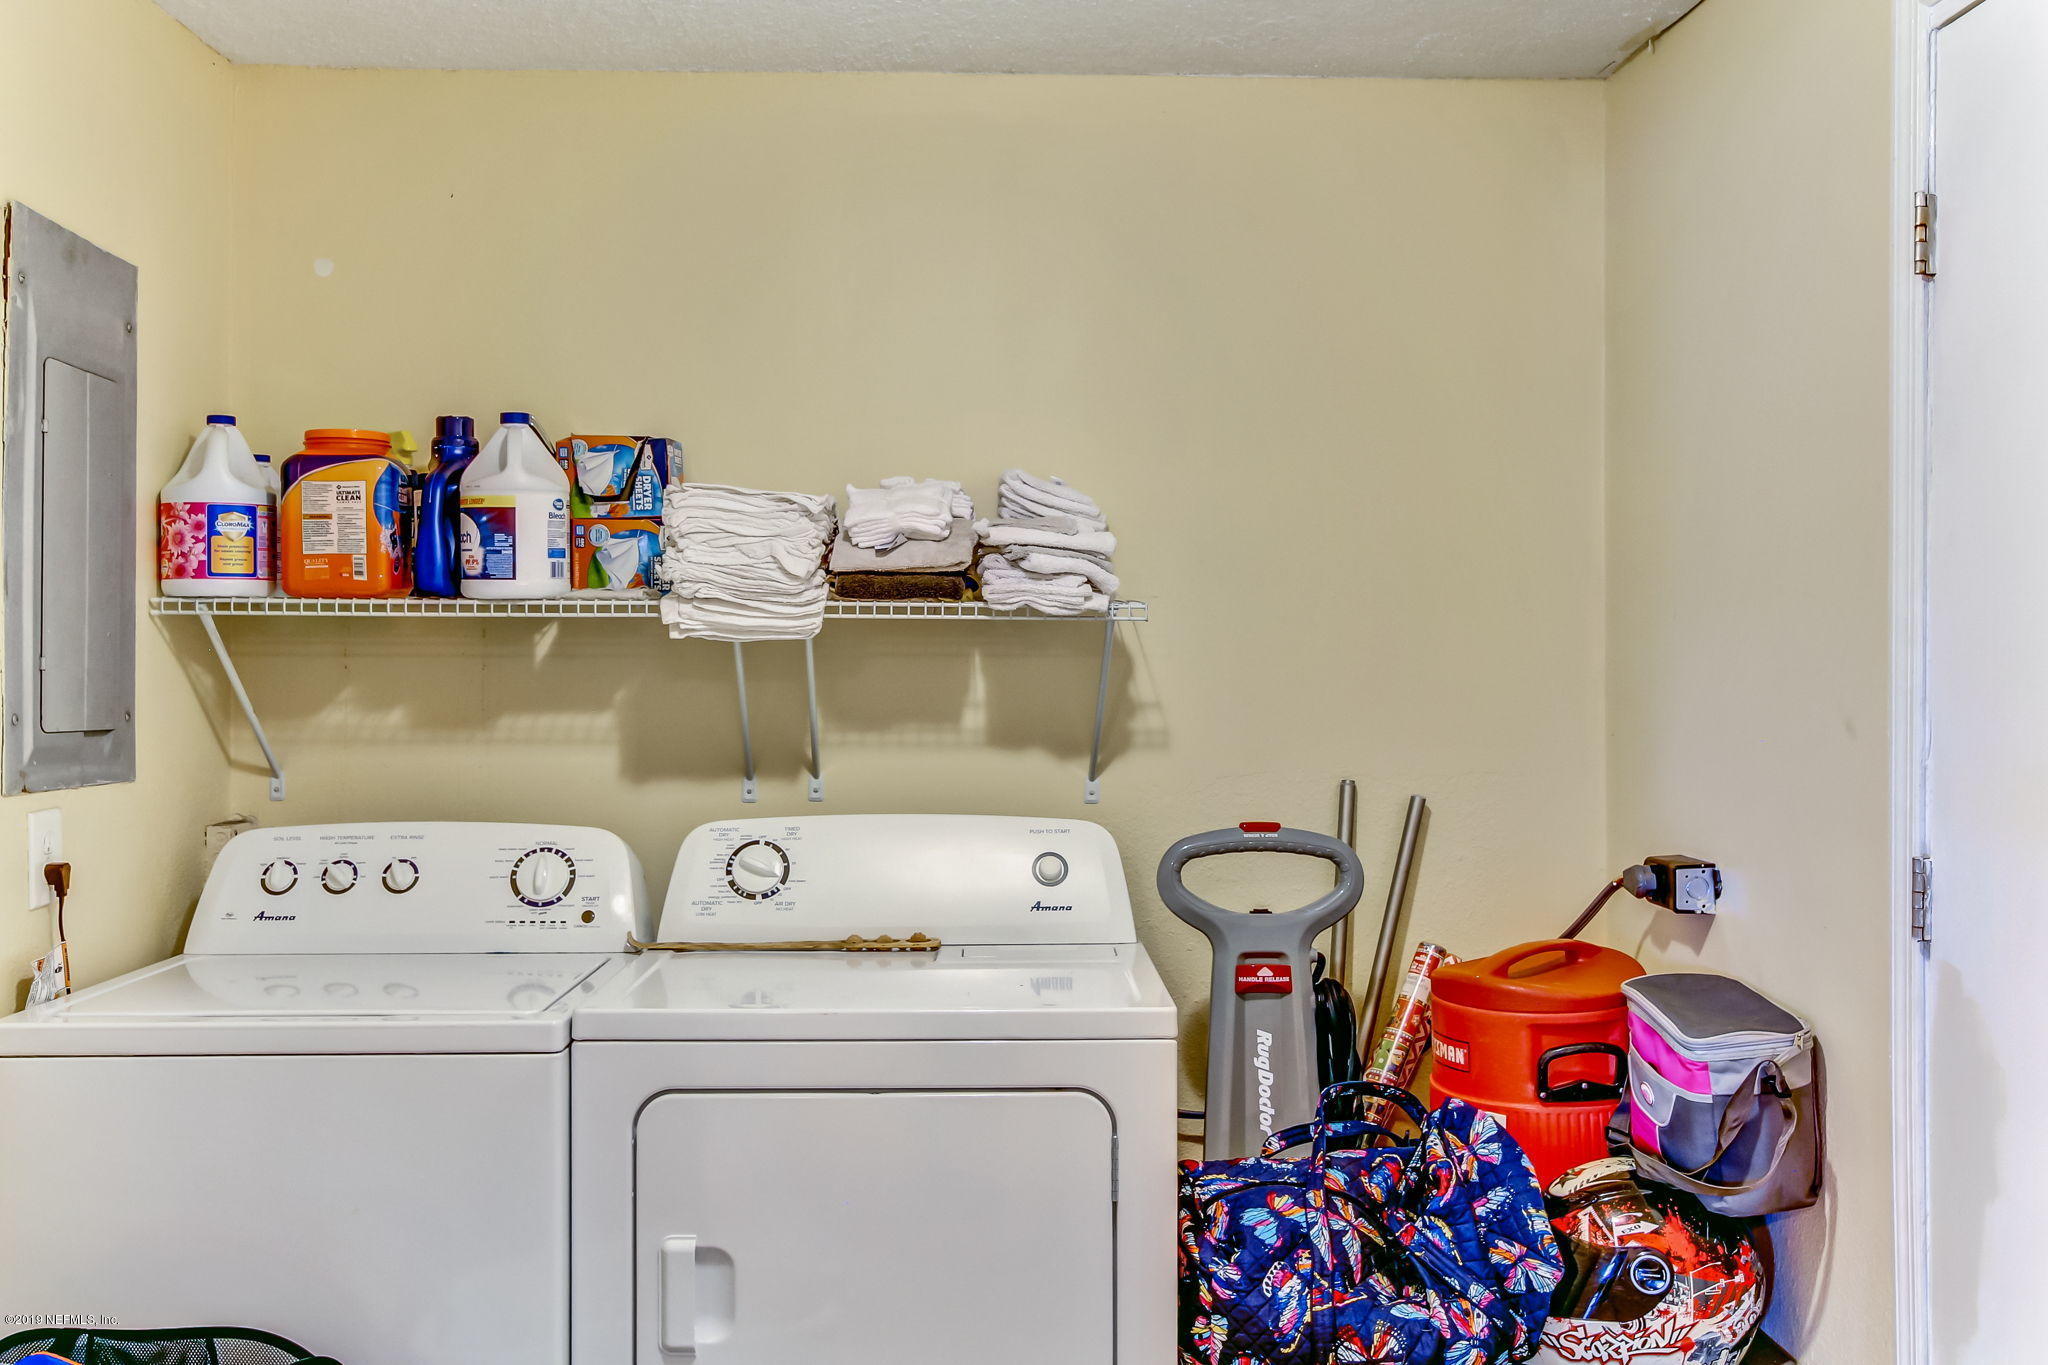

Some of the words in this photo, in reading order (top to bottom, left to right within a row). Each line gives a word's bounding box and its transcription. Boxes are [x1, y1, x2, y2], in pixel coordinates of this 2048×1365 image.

[635, 476, 643, 510] SHEETS
[643, 476, 653, 510] DRYER
[253, 910, 297, 921] Amana
[1030, 900, 1073, 912] Amana
[1253, 1028, 1275, 1139] RugDoctor
